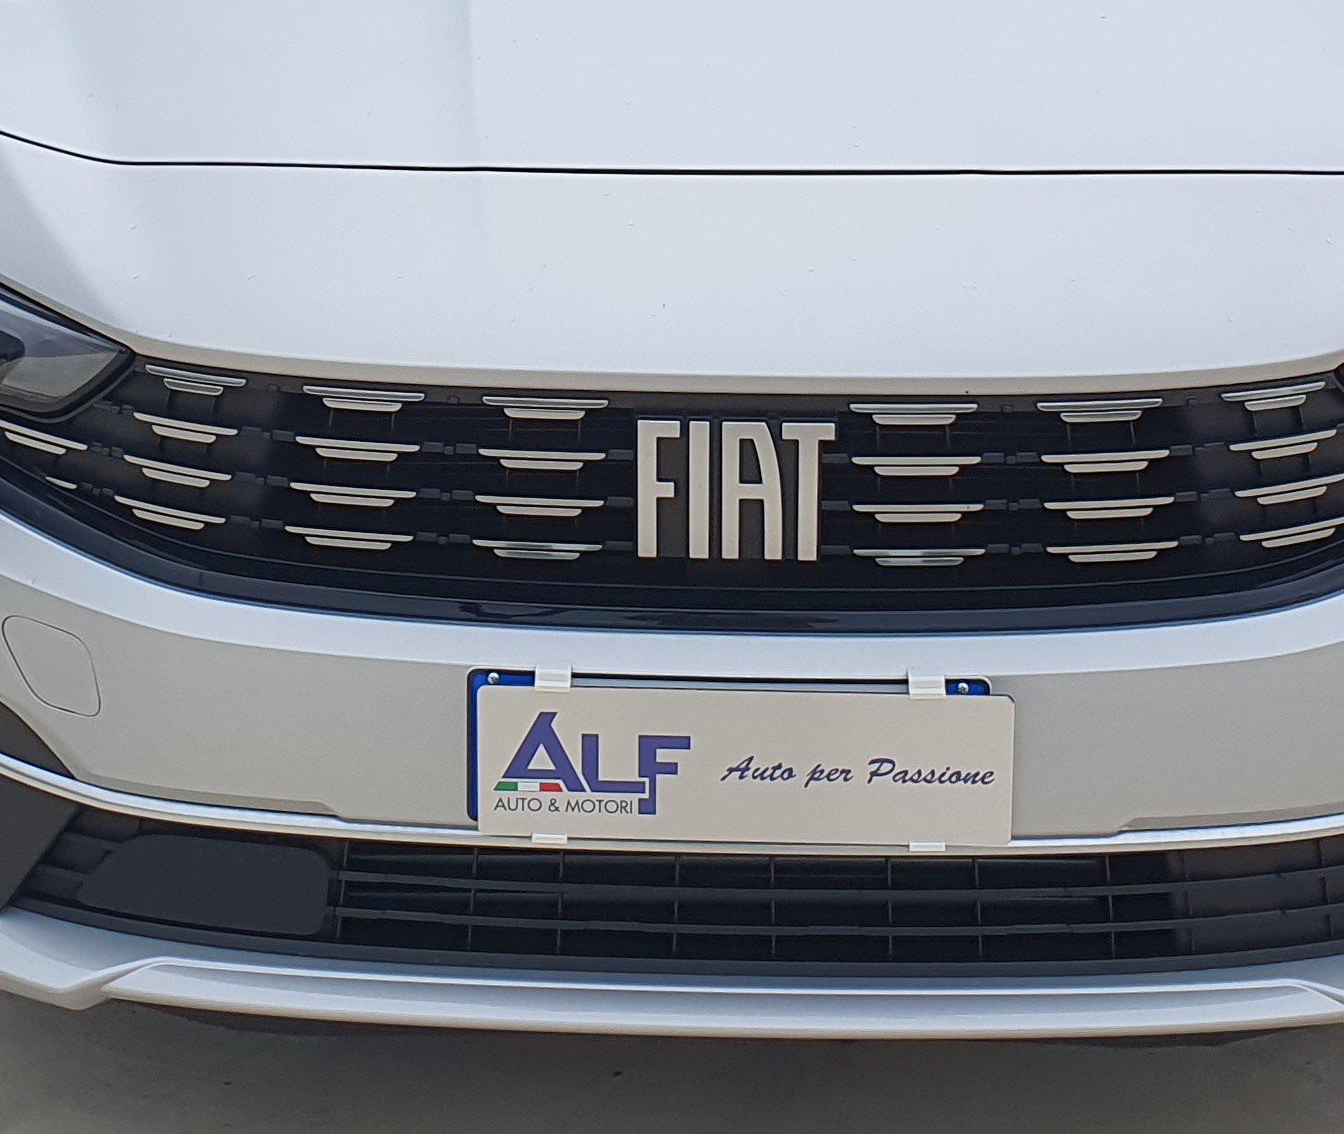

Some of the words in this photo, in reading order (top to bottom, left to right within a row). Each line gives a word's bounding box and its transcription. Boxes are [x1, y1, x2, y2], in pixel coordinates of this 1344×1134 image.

[637, 419, 836, 561] FIAT
[501, 711, 691, 815] ALF
[720, 755, 797, 782] Auto
[804, 763, 854, 788] per
[867, 758, 996, 787] Passione
[493, 797, 542, 813] AUTO
[548, 798, 560, 813] &
[565, 798, 633, 815] MOTORI
